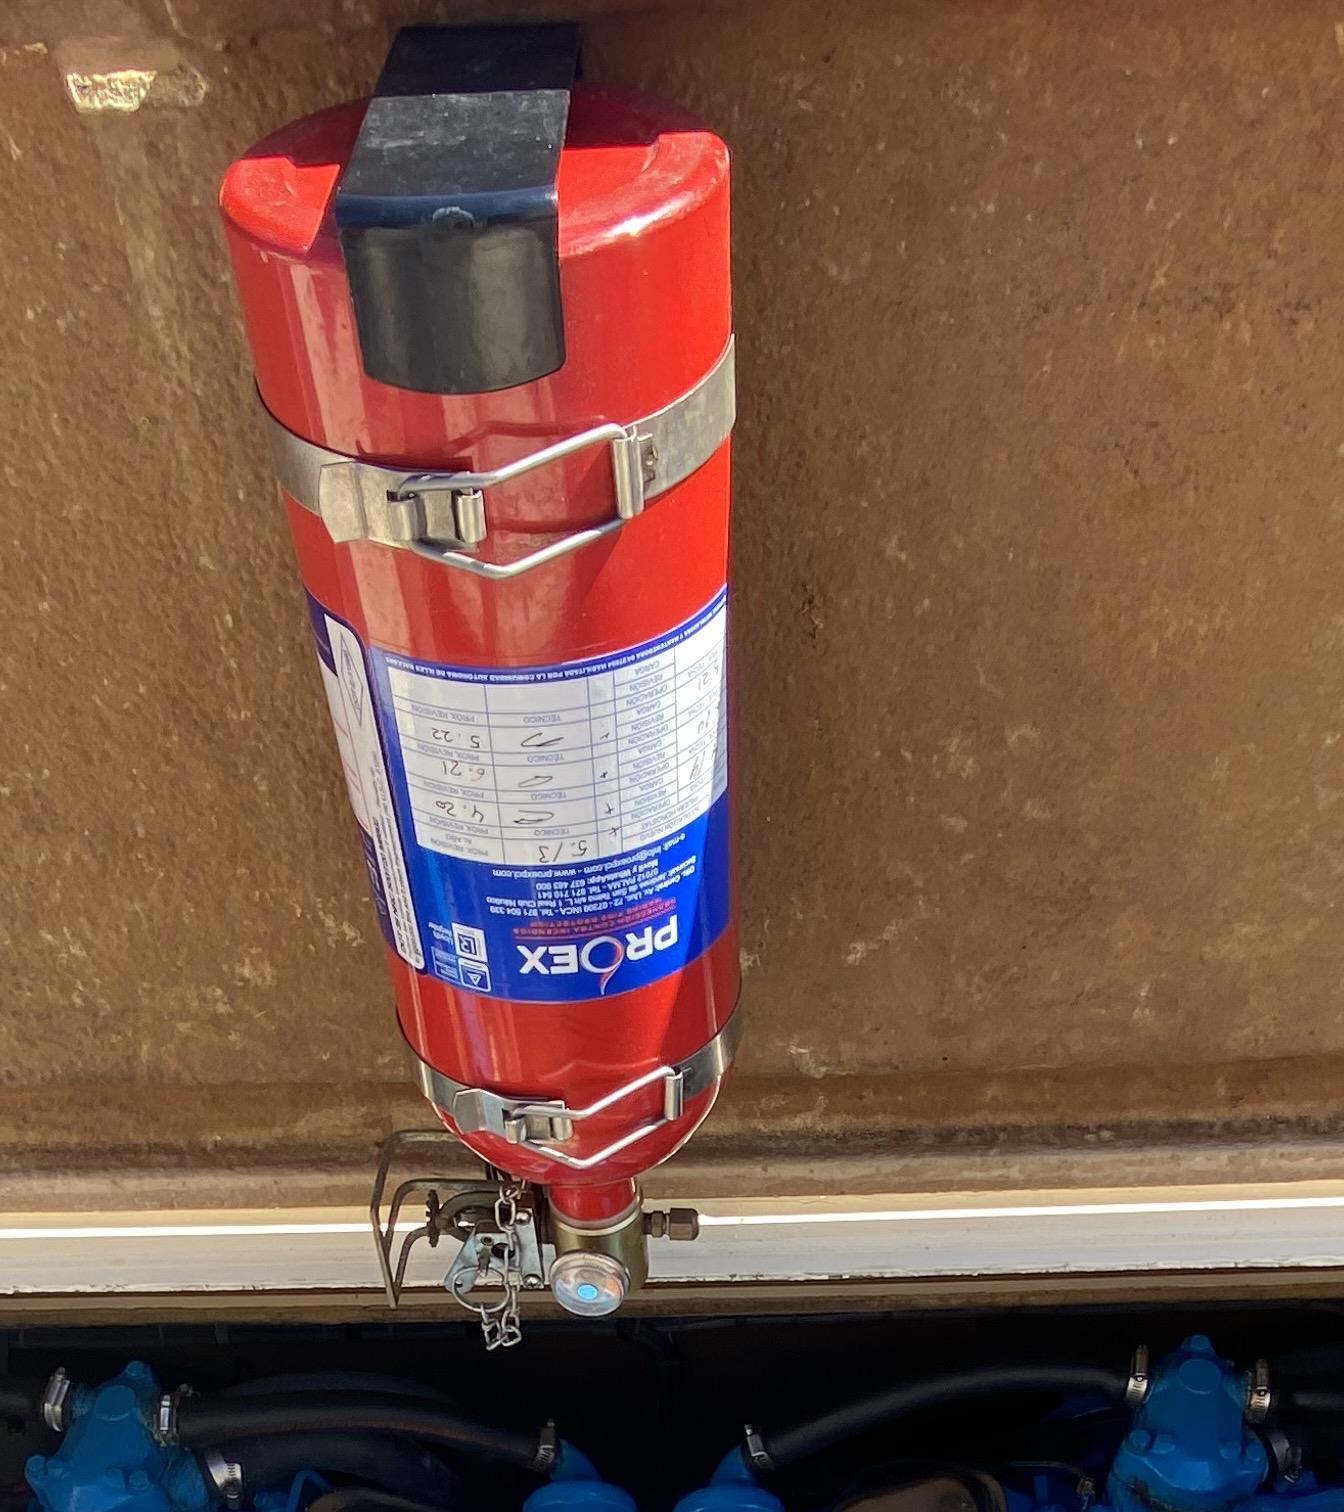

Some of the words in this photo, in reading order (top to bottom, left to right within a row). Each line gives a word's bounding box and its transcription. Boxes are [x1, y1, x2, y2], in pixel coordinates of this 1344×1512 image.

[608, 876, 636, 890] PALMA
[518, 899, 536, 908] Club
[560, 906, 582, 914] INCA
[516, 914, 678, 995] PROEX
